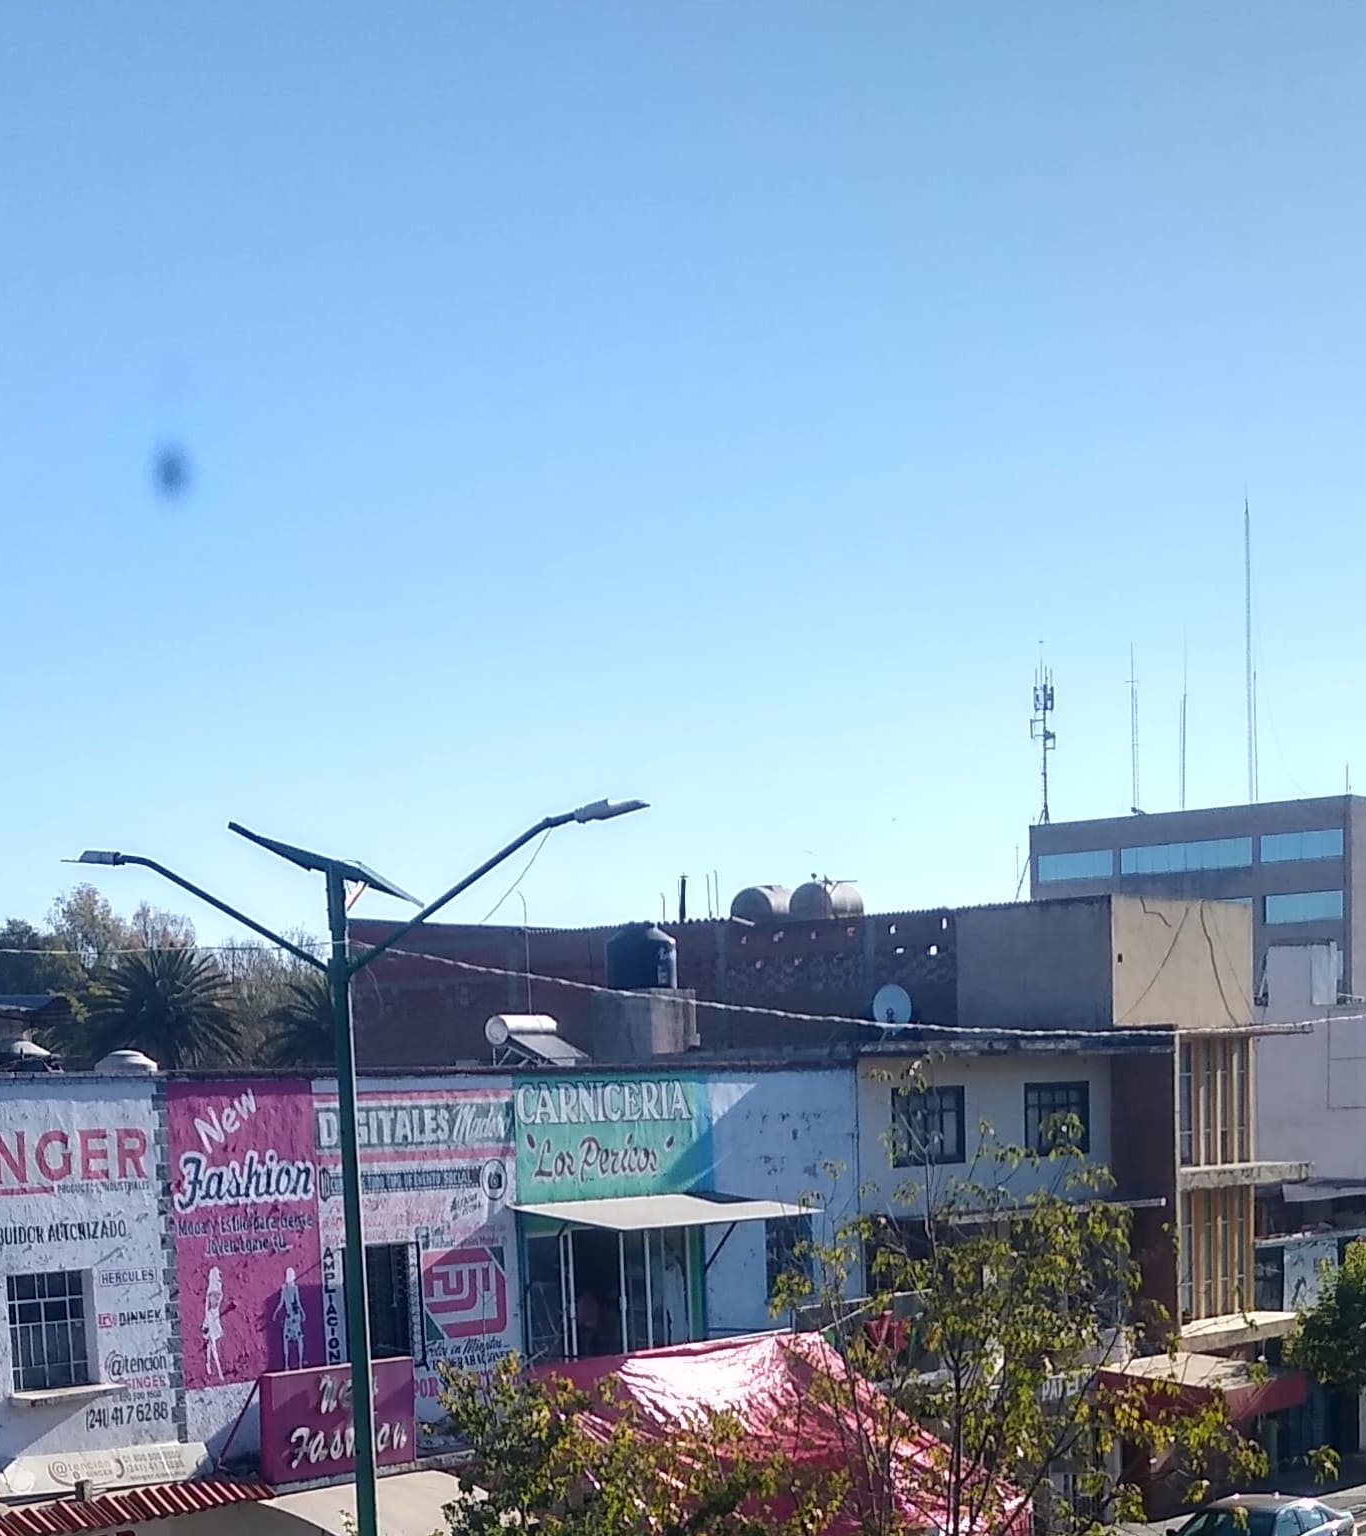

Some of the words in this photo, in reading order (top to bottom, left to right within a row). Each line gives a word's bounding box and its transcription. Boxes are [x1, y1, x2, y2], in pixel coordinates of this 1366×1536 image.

[194, 1088, 256, 1153] New
[516, 1080, 691, 1125] CARNICERIA
[318, 1106, 450, 1147] DGITALES
[175, 1151, 314, 1212] Fashion
[46, 1220, 126, 1243] AUTORIZADO
[101, 1270, 155, 1285] HERCULES
[323, 1247, 342, 1364] AMPLIACION
[290, 1421, 408, 1470] Fashon
